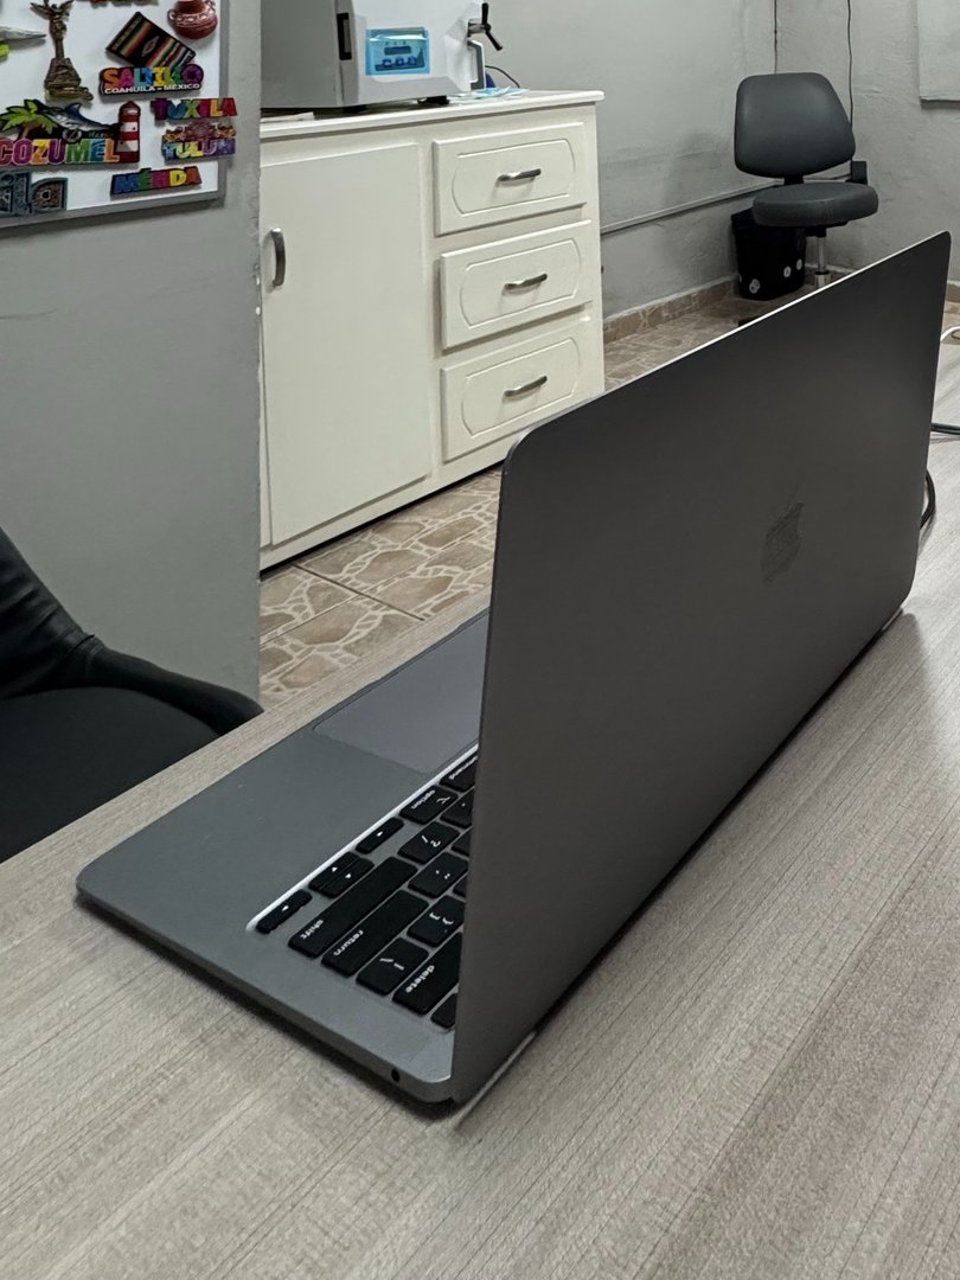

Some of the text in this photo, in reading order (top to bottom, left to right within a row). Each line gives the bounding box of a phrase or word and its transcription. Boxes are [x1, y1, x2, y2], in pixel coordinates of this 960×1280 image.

[0, 138, 120, 166] COZUMEL
[300, 920, 324, 939] shift
[333, 929, 364, 956] return
[405, 965, 435, 993] delete
